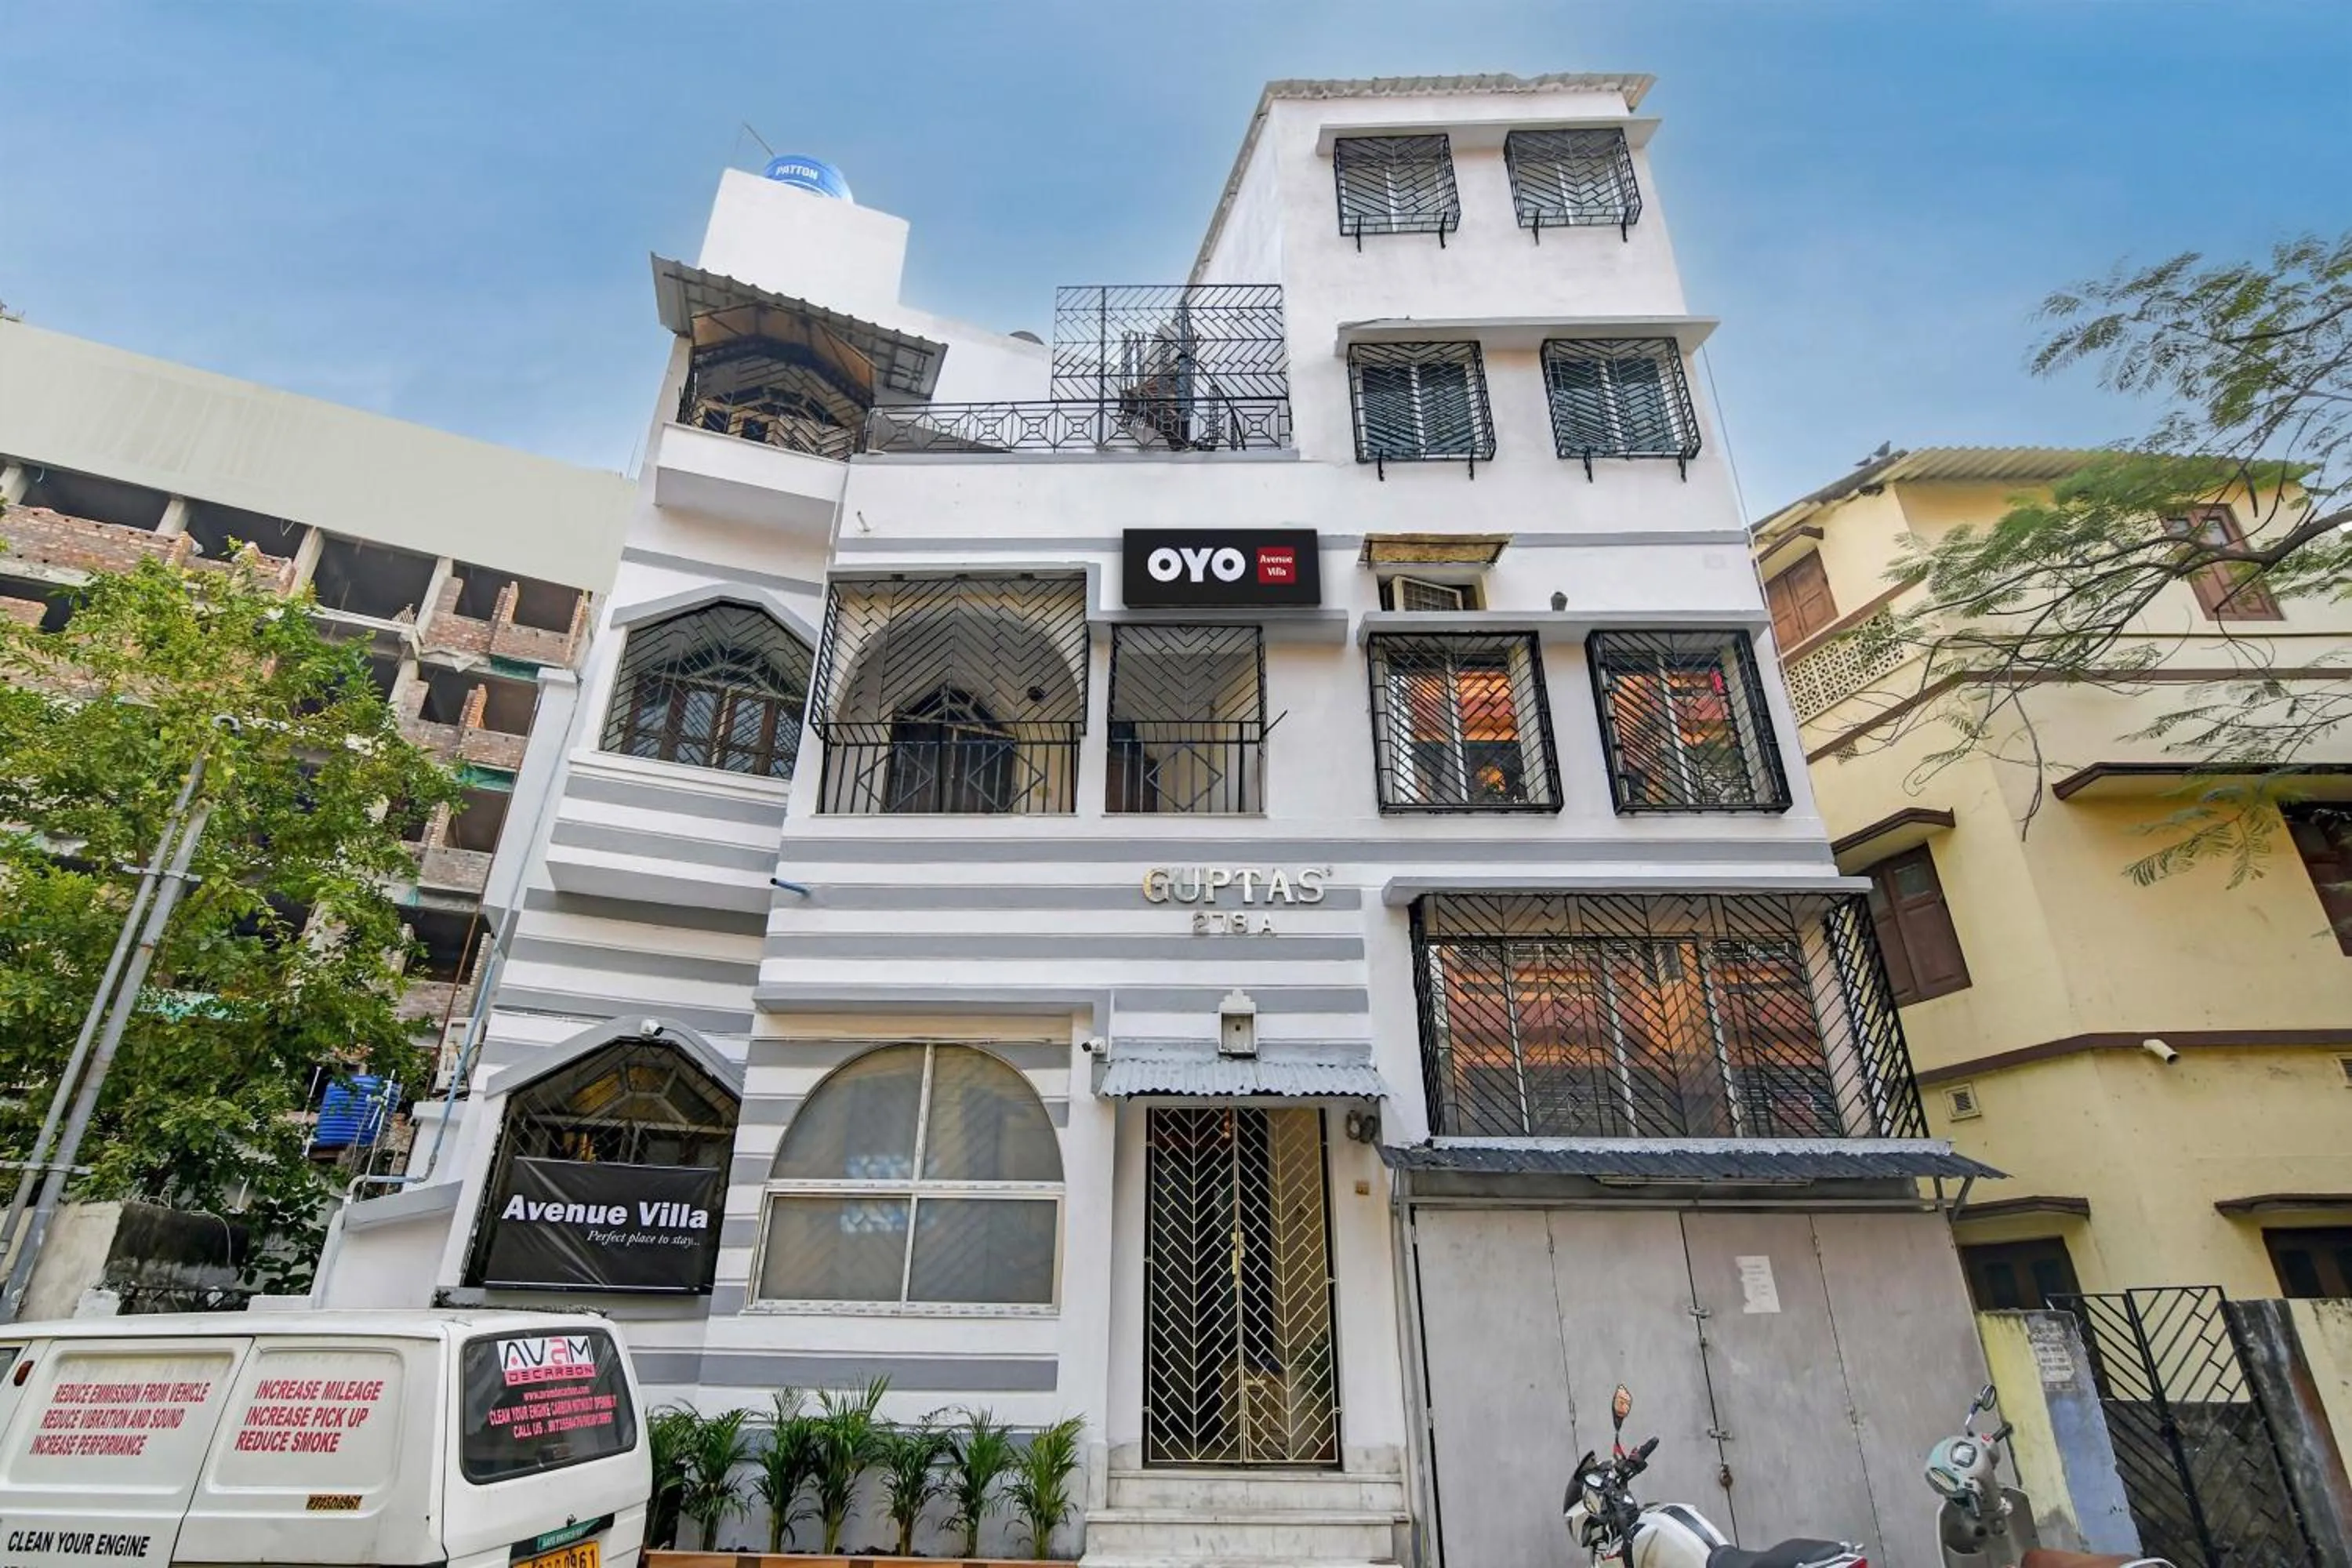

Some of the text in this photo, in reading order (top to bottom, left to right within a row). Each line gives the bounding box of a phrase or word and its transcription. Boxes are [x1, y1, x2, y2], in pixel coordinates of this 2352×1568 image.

[775, 164, 818, 180] PATTON
[1147, 547, 1246, 583] OYO
[1260, 554, 1293, 564] Avenue
[1267, 566, 1287, 576] Villa
[502, 1194, 709, 1229] Avenue Villa
[586, 1230, 626, 1246] Perfect
[627, 1231, 656, 1246] place
[658, 1231, 670, 1244] to
[509, 1367, 593, 1383] DECARBON
[52, 1385, 93, 1403] REDUCE
[140, 1384, 172, 1403] FROM
[169, 1382, 211, 1403] VEHICLE
[254, 1380, 383, 1401] INCREASE MILEAGE
[41, 1409, 186, 1428] REDUCE VIBRATION AND SOUND
[245, 1406, 369, 1428] INCREASE PICK UP
[514, 1420, 532, 1439] CALL
[30, 1435, 147, 1455] INCREASE PERFORMANCE
[235, 1431, 342, 1453] REDUCE SMOKE
[8, 1531, 151, 1558] CLEAN YOUR ENGINE
